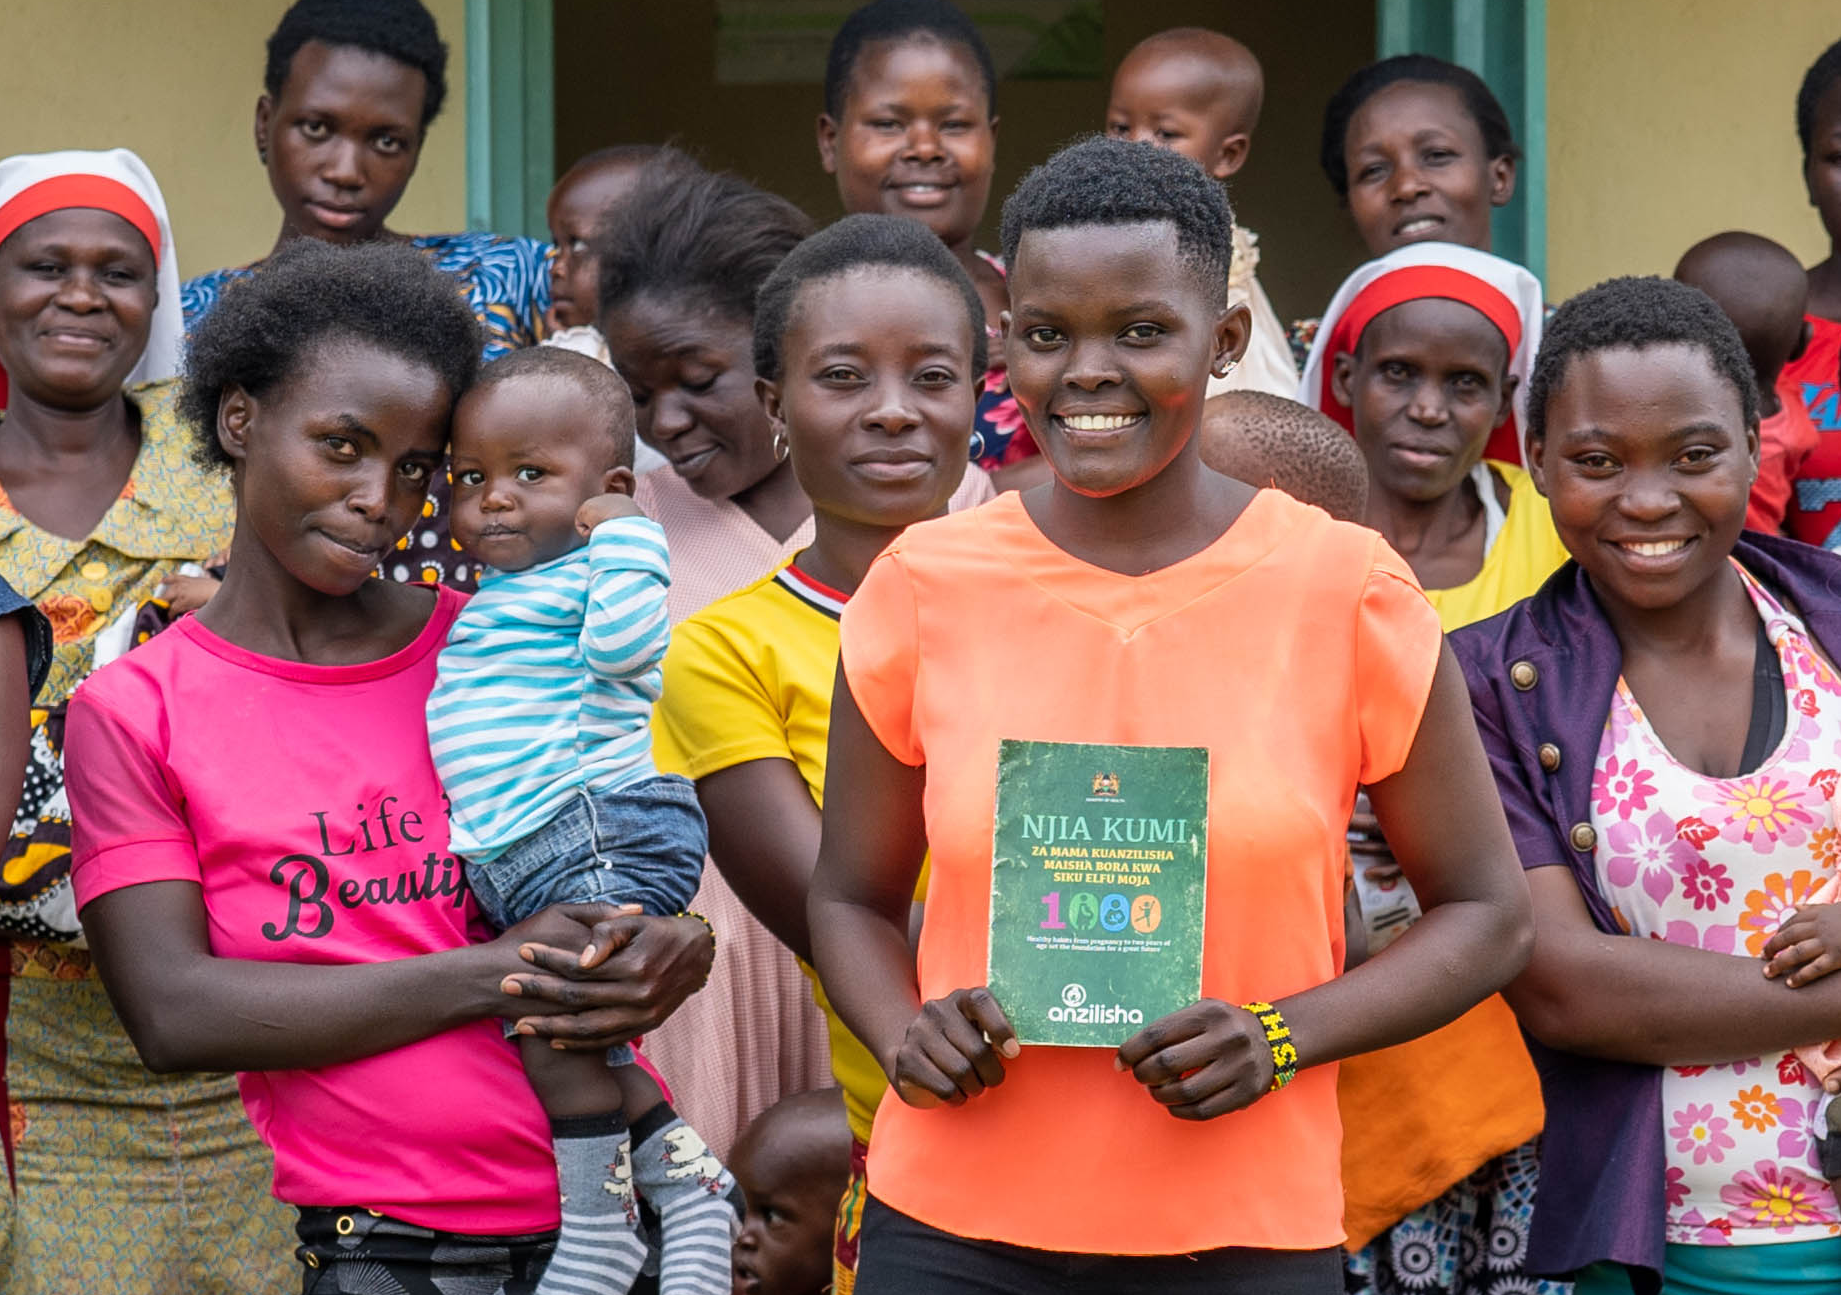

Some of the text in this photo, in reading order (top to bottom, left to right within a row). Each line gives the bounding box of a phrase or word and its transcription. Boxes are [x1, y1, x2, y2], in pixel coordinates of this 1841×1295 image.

[309, 796, 425, 856] Life
[1021, 814, 1188, 845] NJIA KUMI
[1031, 846, 1175, 861] ZA MAMA KUANZILISHA
[1044, 859, 1162, 874] MAISHA BORA KWA
[1054, 872, 1151, 887] SIKU ELFU MOJA
[1047, 1003, 1144, 1025] anzilisha
